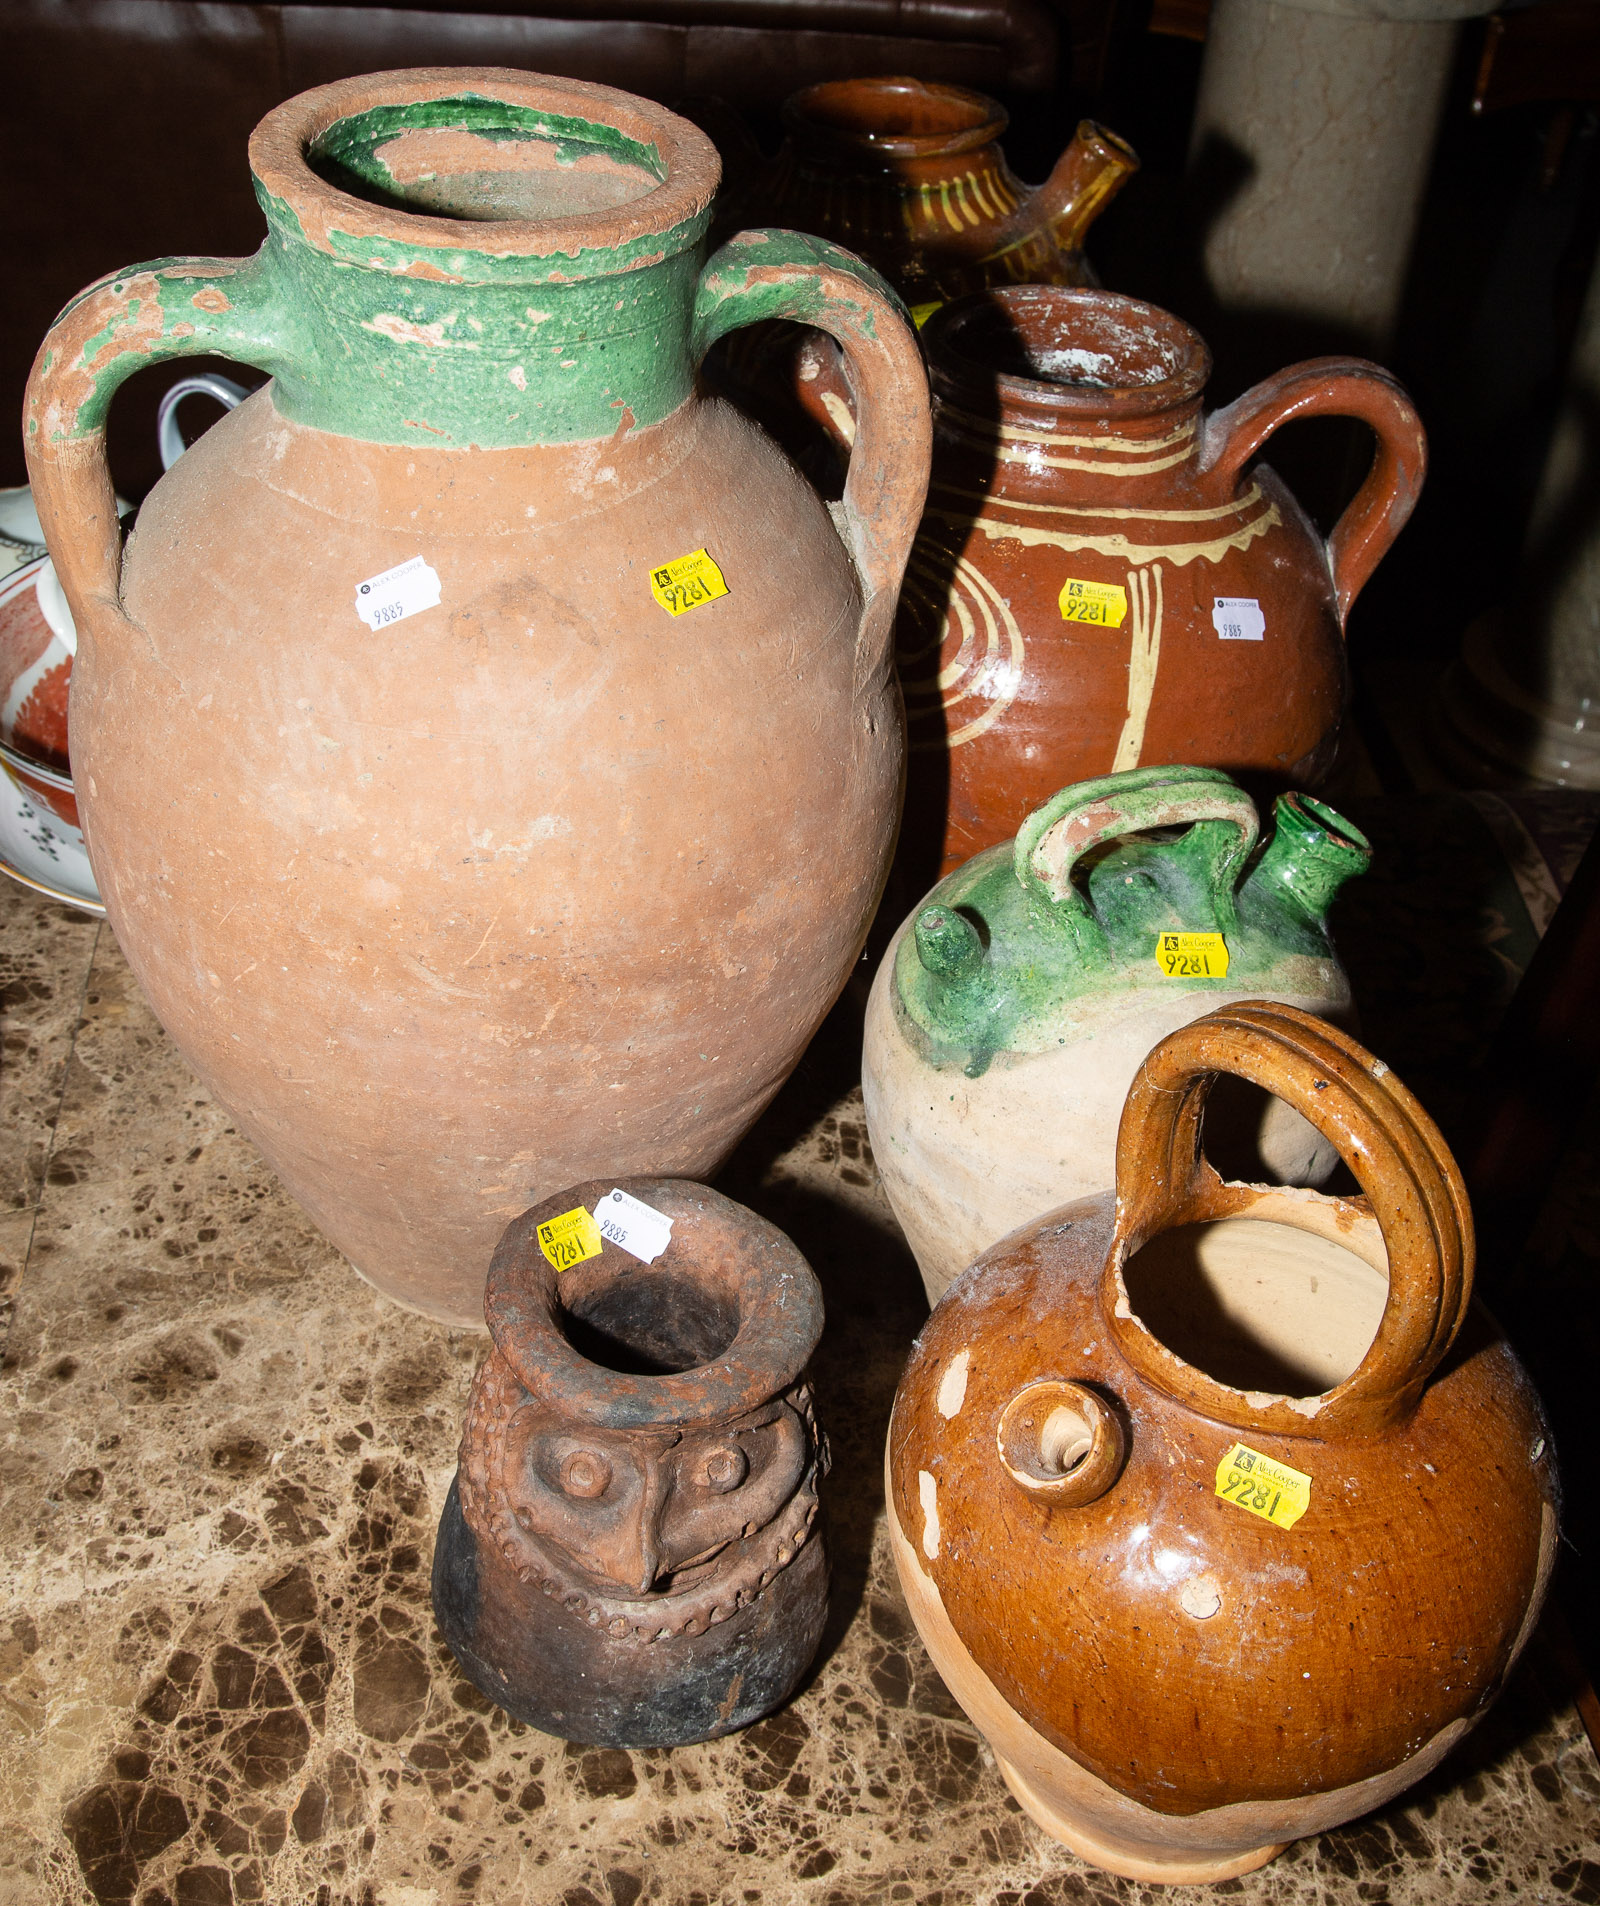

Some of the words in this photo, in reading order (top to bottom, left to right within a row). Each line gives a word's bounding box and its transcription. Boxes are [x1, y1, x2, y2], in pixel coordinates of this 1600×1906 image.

[372, 575, 390, 589] ALEX
[391, 561, 422, 580] COOPER
[682, 559, 703, 571] Cooper
[664, 576, 711, 611] 9281
[374, 601, 403, 625] 9885
[1067, 599, 1107, 623] 9281
[1223, 624, 1242, 637] 9885
[1166, 954, 1210, 975] 9281
[623, 1199, 639, 1213] ALEX
[600, 1219, 628, 1244] 9885
[549, 1233, 585, 1267] 9281
[1255, 1461, 1272, 1475] Alex
[1273, 1468, 1301, 1488] Cooper
[1222, 1471, 1281, 1517] 9281
